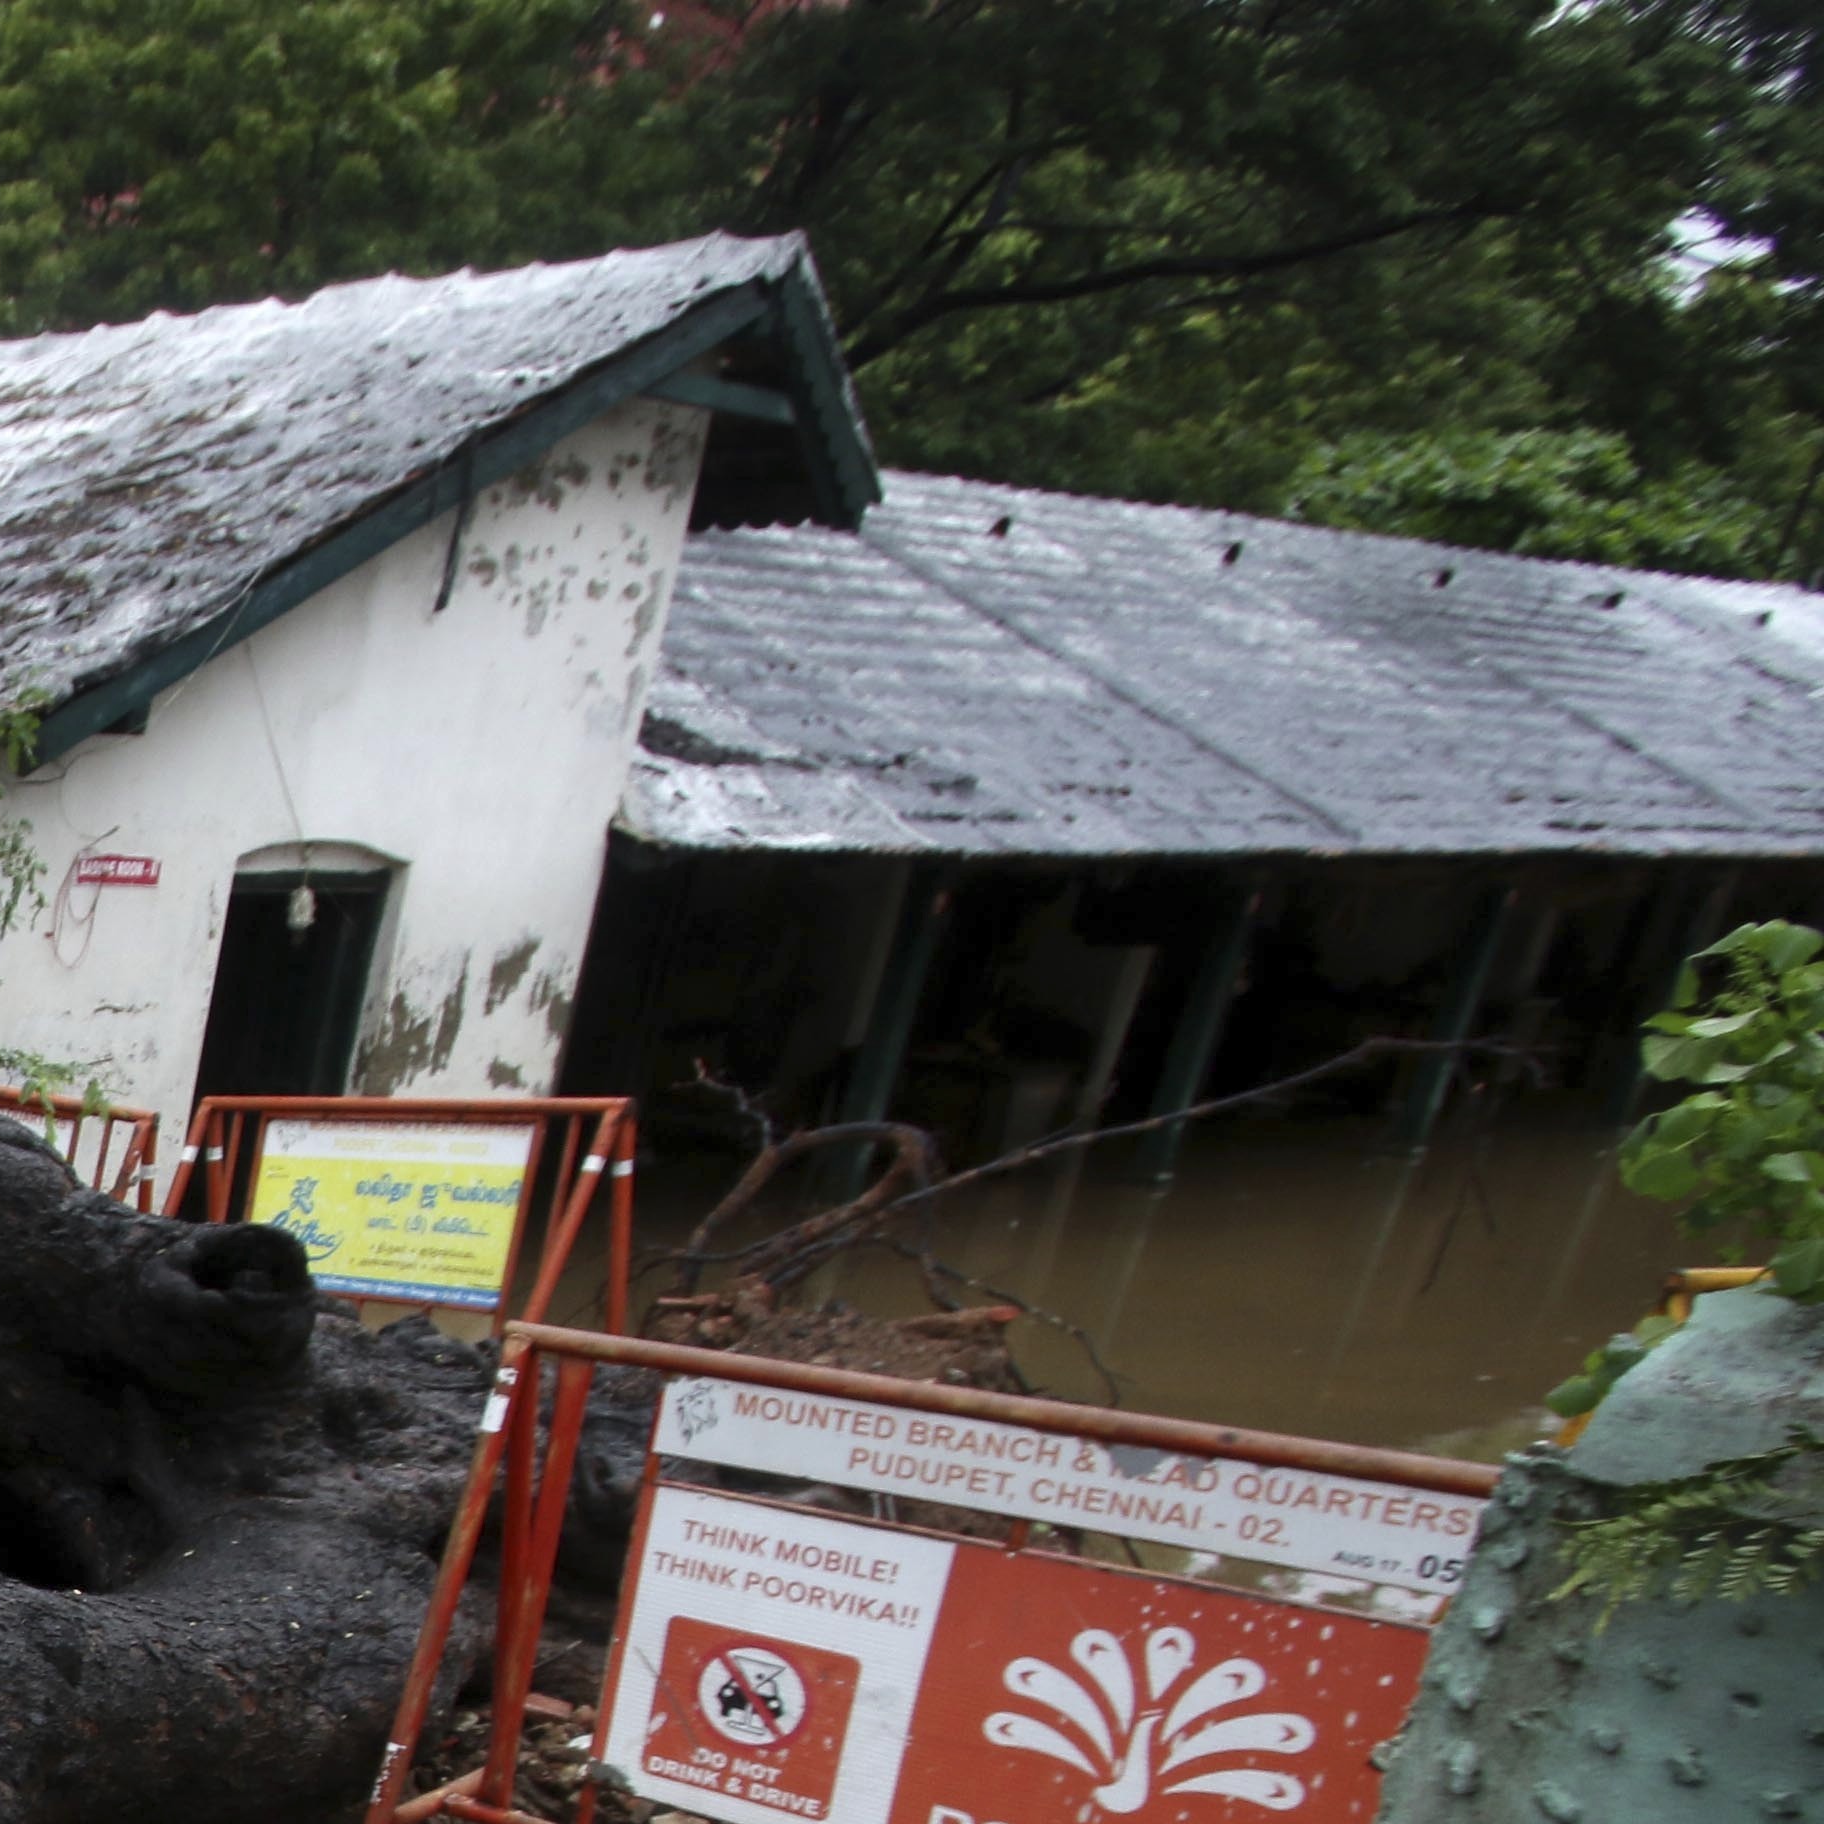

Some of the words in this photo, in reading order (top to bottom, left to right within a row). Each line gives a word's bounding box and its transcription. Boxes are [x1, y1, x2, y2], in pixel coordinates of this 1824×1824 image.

[732, 1391, 898, 1441] MOUNTED
[906, 1420, 1064, 1468] BRANCH
[1231, 1471, 1473, 1539] QUARTERS
[847, 1446, 1017, 1502] PUDUPET,
[1028, 1477, 1204, 1532] CHENNAI
[1237, 1514, 1291, 1548] 02.
[682, 1519, 768, 1556] THINK
[774, 1539, 900, 1584] MOBILE!
[1331, 1550, 1377, 1570] AUG
[654, 1551, 737, 1588] THINK
[742, 1571, 920, 1628] POORVIKA!!
[648, 1755, 721, 1789] DRINK
[725, 1777, 743, 1794] &
[748, 1783, 823, 1816] DRIVE
[692, 1747, 727, 1769] DO
[731, 1758, 782, 1783] NOT
